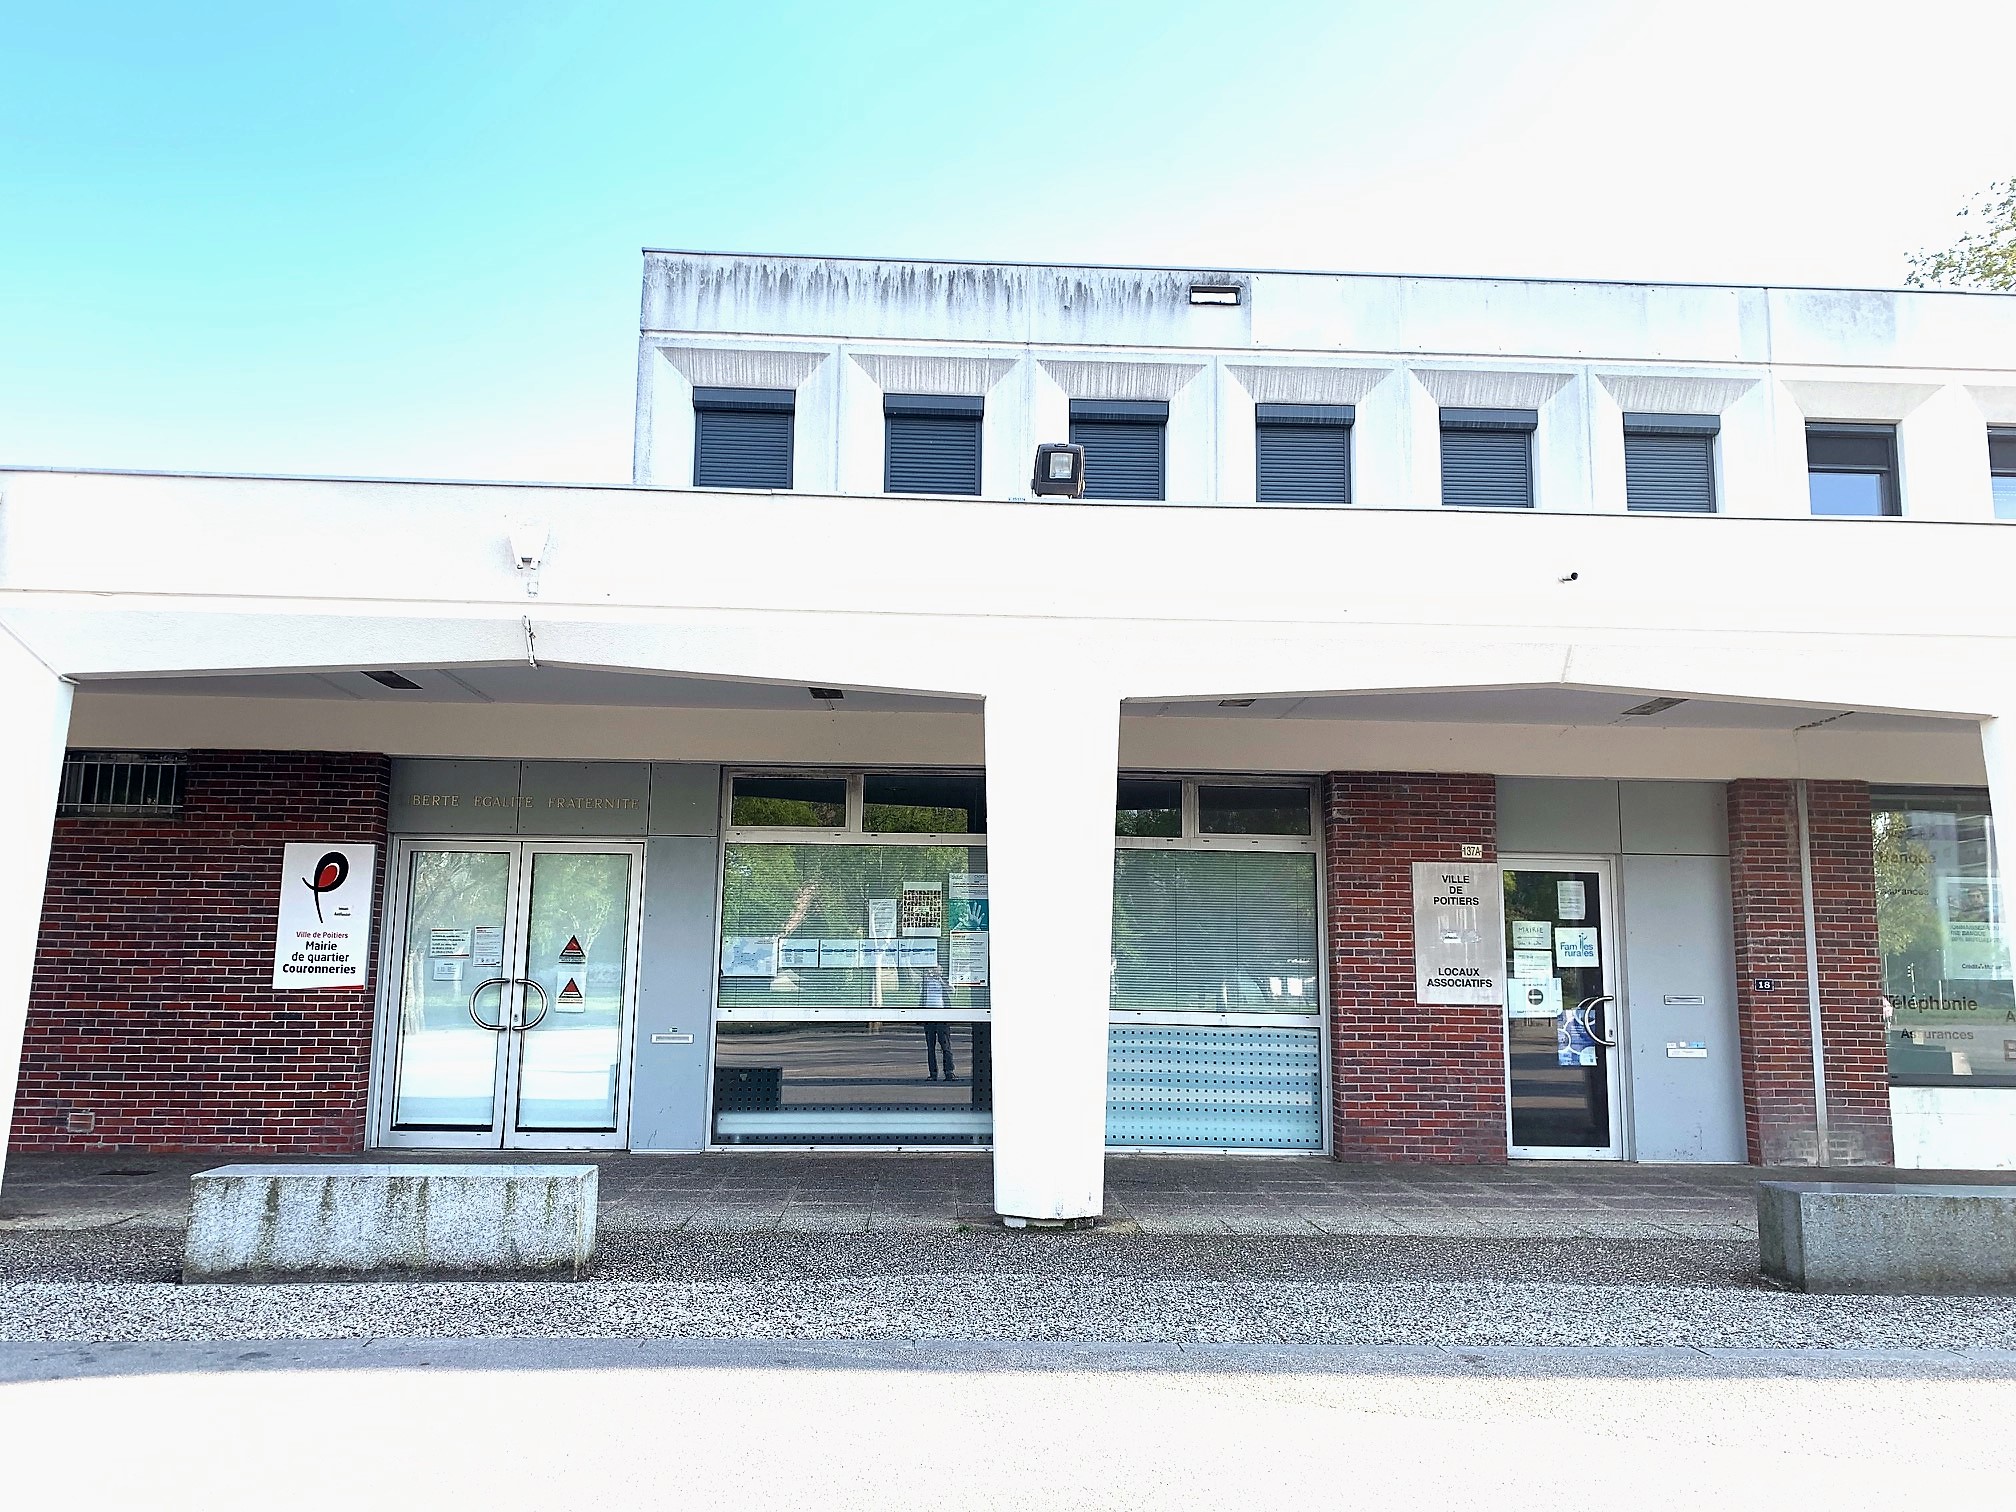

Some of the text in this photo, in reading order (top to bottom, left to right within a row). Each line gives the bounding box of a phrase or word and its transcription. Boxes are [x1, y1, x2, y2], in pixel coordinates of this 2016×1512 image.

[1441, 875, 1470, 884] VILLE
[1449, 886, 1463, 895] DE
[1433, 897, 1479, 906] POITIERS
[322, 931, 349, 939] Poitiers
[305, 941, 337, 951] Mairie
[291, 951, 350, 963] de quartier
[282, 963, 356, 974] Couronneries
[1438, 968, 1480, 977] LOCAUX
[1426, 978, 1493, 988] ASSOCIATIFS
[1758, 981, 1771, 989] 18
